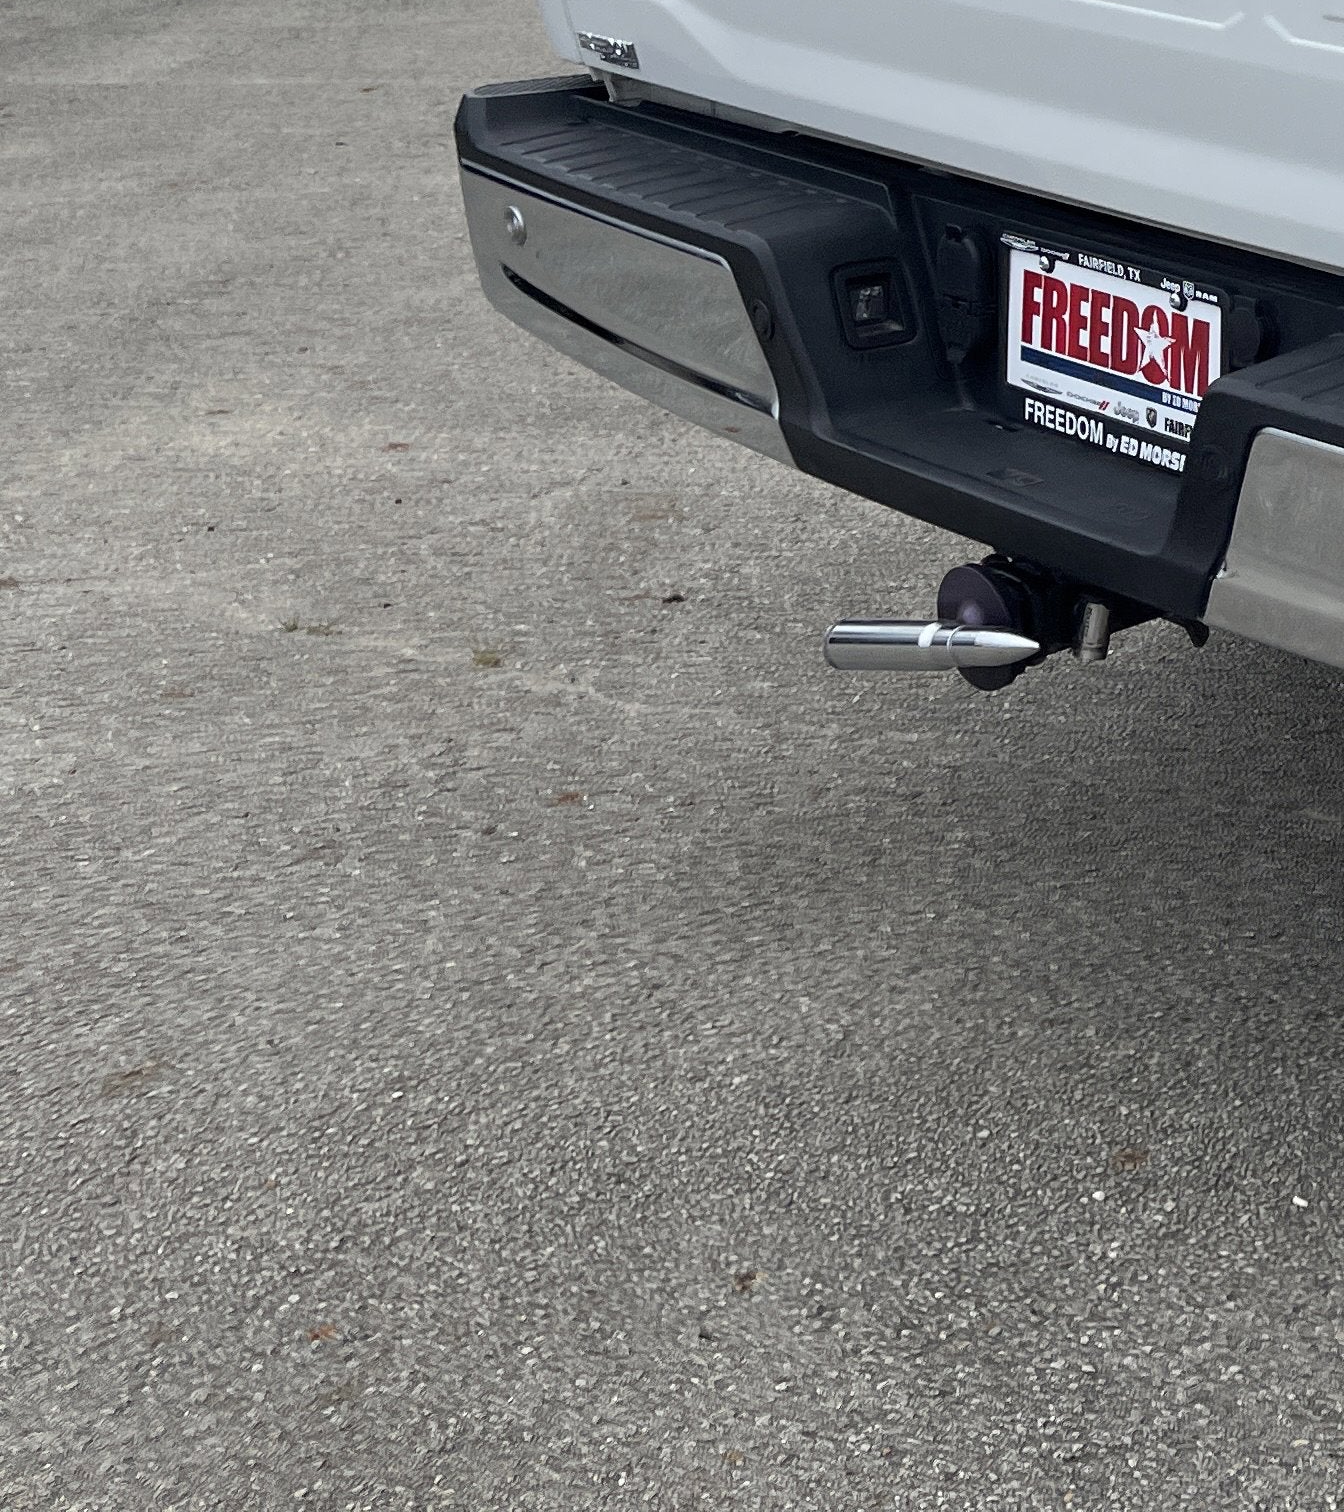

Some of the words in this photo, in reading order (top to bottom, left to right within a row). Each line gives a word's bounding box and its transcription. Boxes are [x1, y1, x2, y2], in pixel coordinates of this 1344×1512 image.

[1078, 253, 1126, 280] FAIRFIELD,
[1127, 266, 1141, 282] TX
[1160, 278, 1181, 293] Jeep
[1195, 290, 1218, 303] RAM
[1021, 269, 1210, 397] FREEDOM
[1114, 401, 1140, 424] Jeep
[1025, 397, 1104, 445] FREEDOM
[1120, 435, 1139, 457] ED
